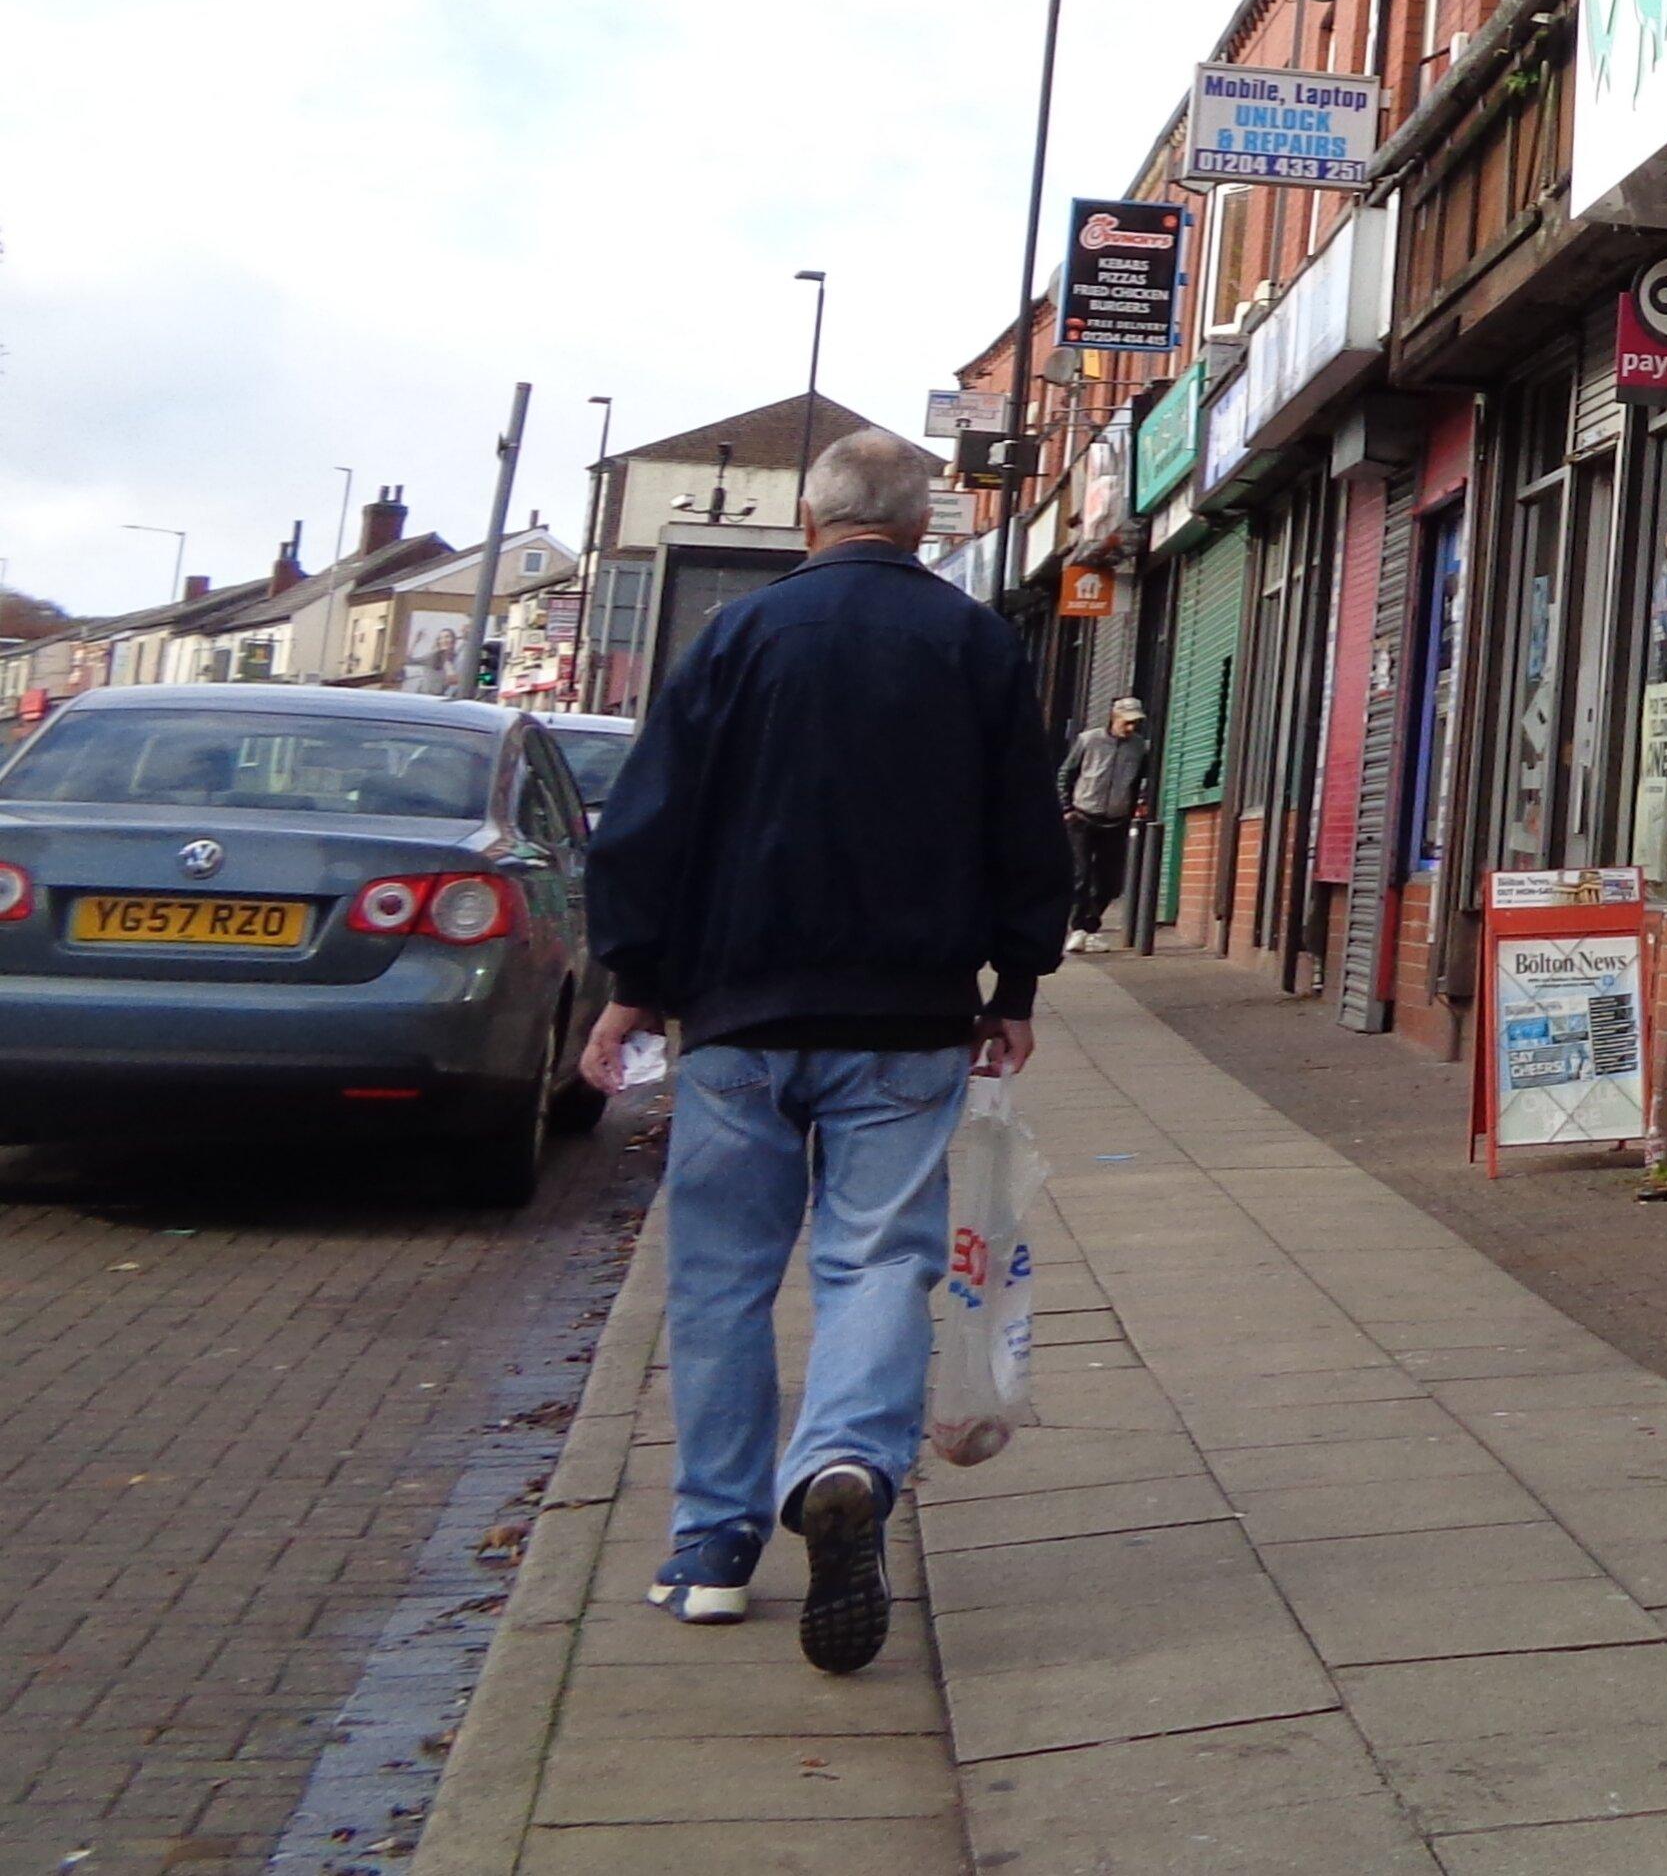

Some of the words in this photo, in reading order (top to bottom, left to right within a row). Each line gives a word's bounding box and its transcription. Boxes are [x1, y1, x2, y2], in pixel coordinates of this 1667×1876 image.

[1204, 75, 1286, 106] Mobile,
[1295, 83, 1367, 112] Laptop
[1235, 104, 1333, 133] UNLOCK
[1217, 128, 1234, 151] &
[1243, 130, 1347, 158] REPAIRS
[1198, 152, 1267, 175] 01204
[1274, 158, 1319, 179] 433
[1325, 162, 1363, 182] 251
[1098, 257, 1150, 271] KEBABS
[1098, 271, 1147, 285] PIZZAS
[1073, 284, 1109, 297] FRIED
[1111, 286, 1169, 301] CHICKEN
[1089, 299, 1151, 314] BURGERS
[97, 899, 200, 934] YG57
[1516, 952, 1574, 975] Bolton
[1579, 950, 1627, 972] News
